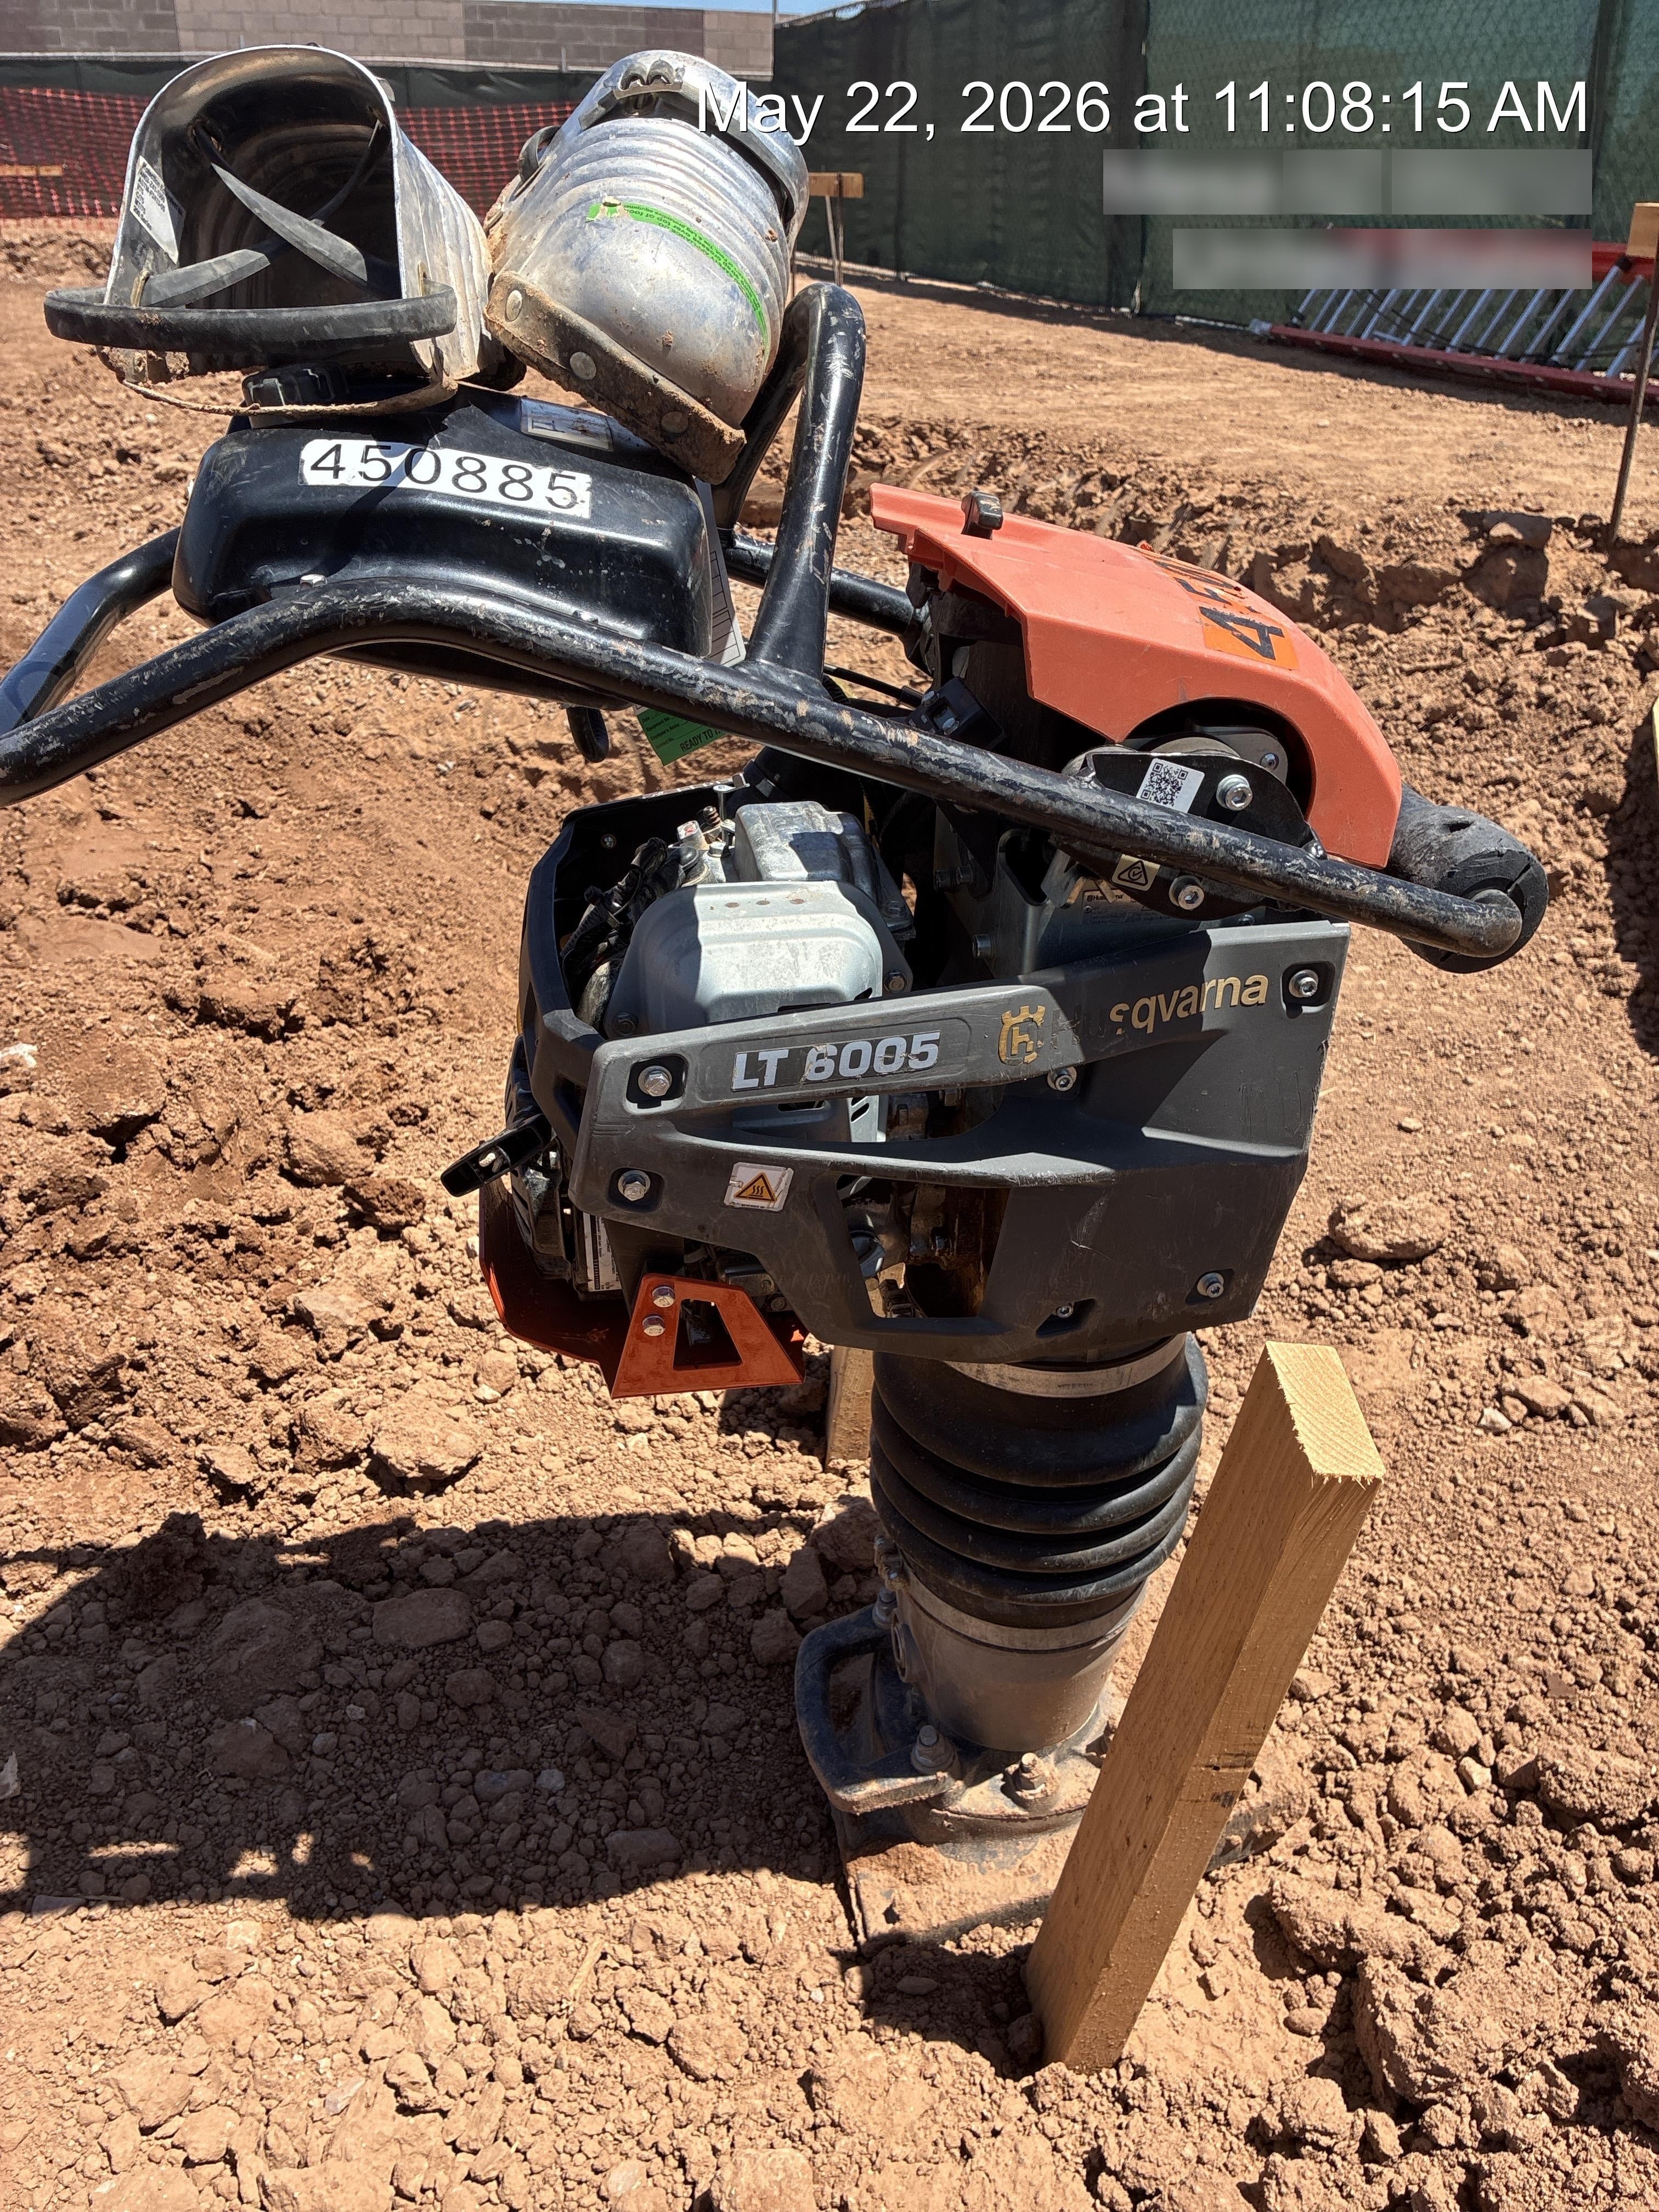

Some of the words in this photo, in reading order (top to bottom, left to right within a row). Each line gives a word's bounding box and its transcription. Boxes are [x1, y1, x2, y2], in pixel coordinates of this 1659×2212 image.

[653, 211, 686, 229] protective
[656, 216, 671, 226] top
[671, 223, 691, 238] over
[685, 227, 698, 237] Leg
[310, 443, 579, 510] 450885
[680, 735, 704, 753] READY
[702, 729, 714, 741] TO
[1109, 974, 1269, 1036] sqvarna
[732, 1048, 789, 1090] LT
[803, 1032, 941, 1082] 6005
